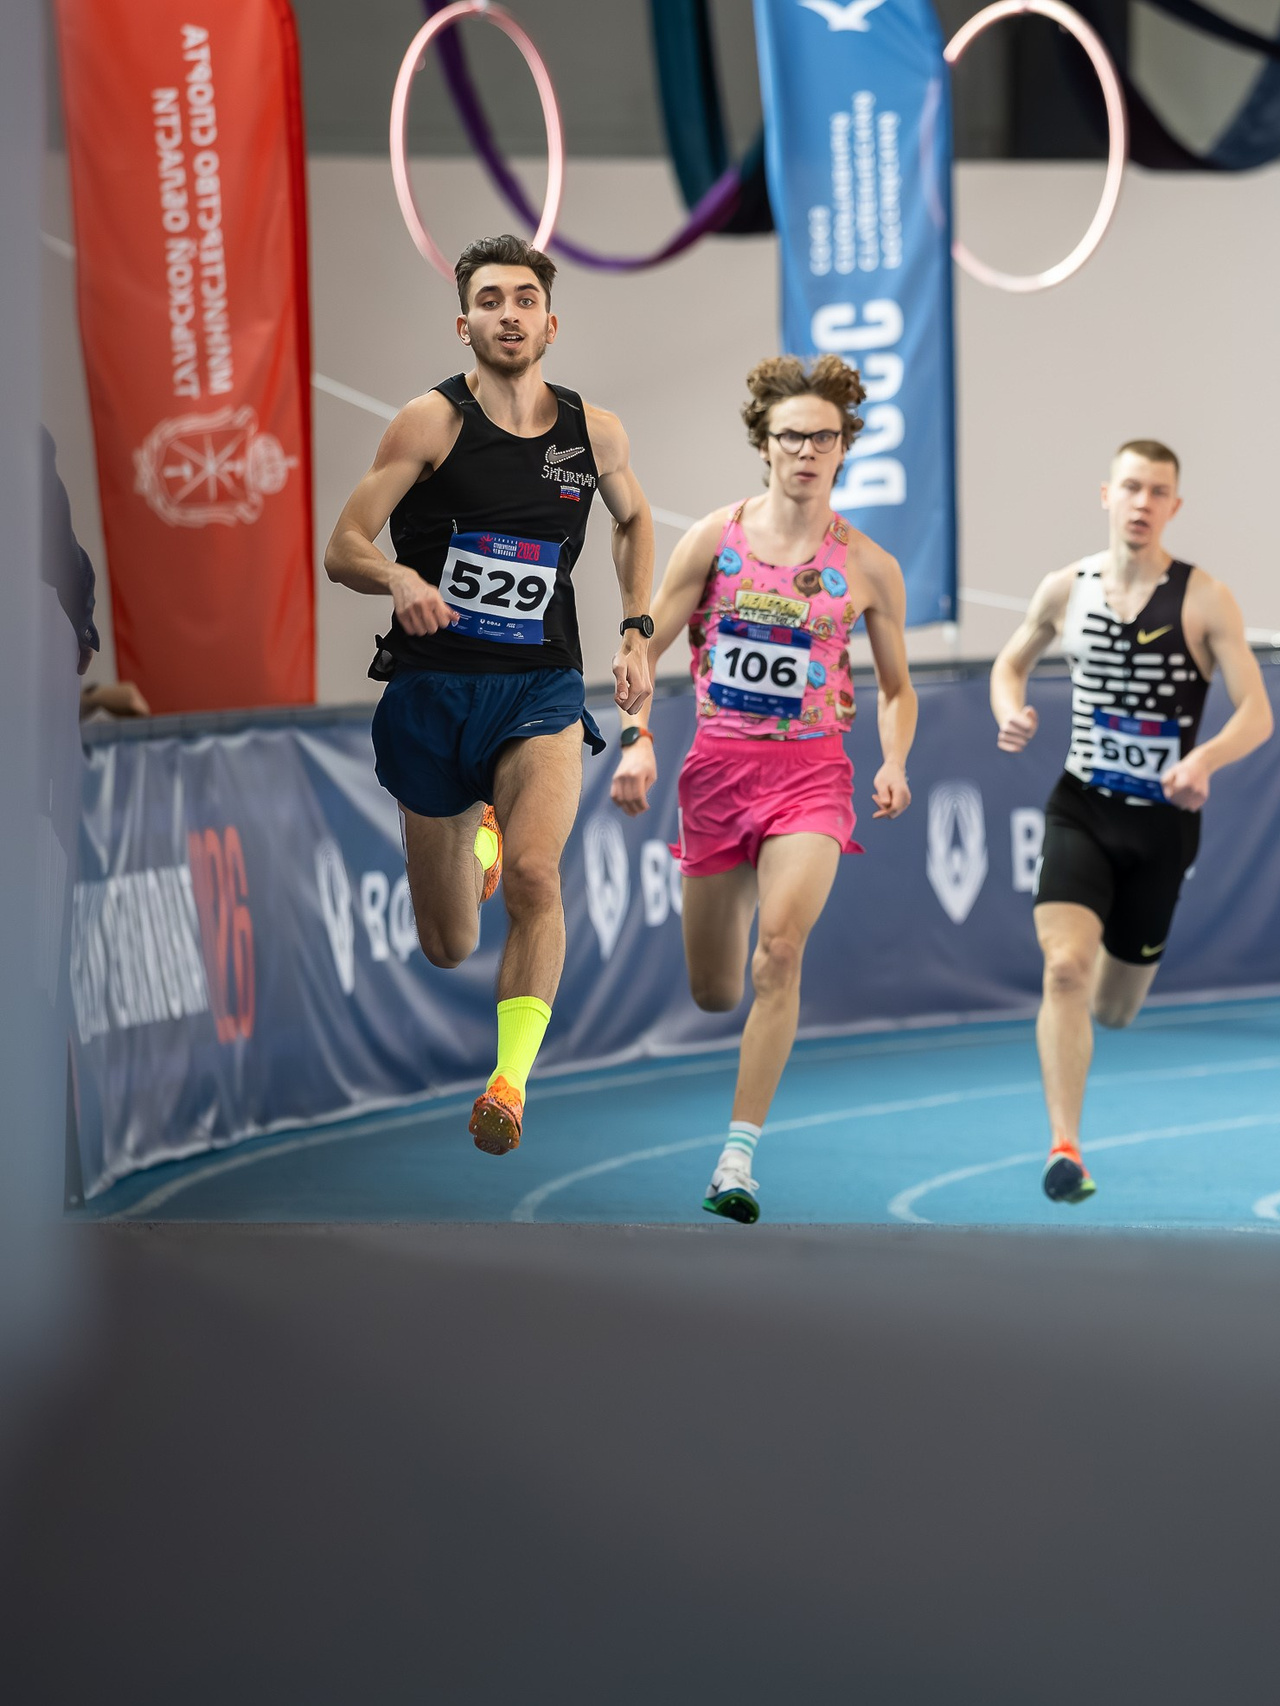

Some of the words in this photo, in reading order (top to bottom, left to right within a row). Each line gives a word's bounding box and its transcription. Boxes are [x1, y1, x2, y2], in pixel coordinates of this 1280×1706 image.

[448, 559, 548, 612] 529
[724, 647, 798, 687] 106
[1101, 737, 1170, 774] 507
